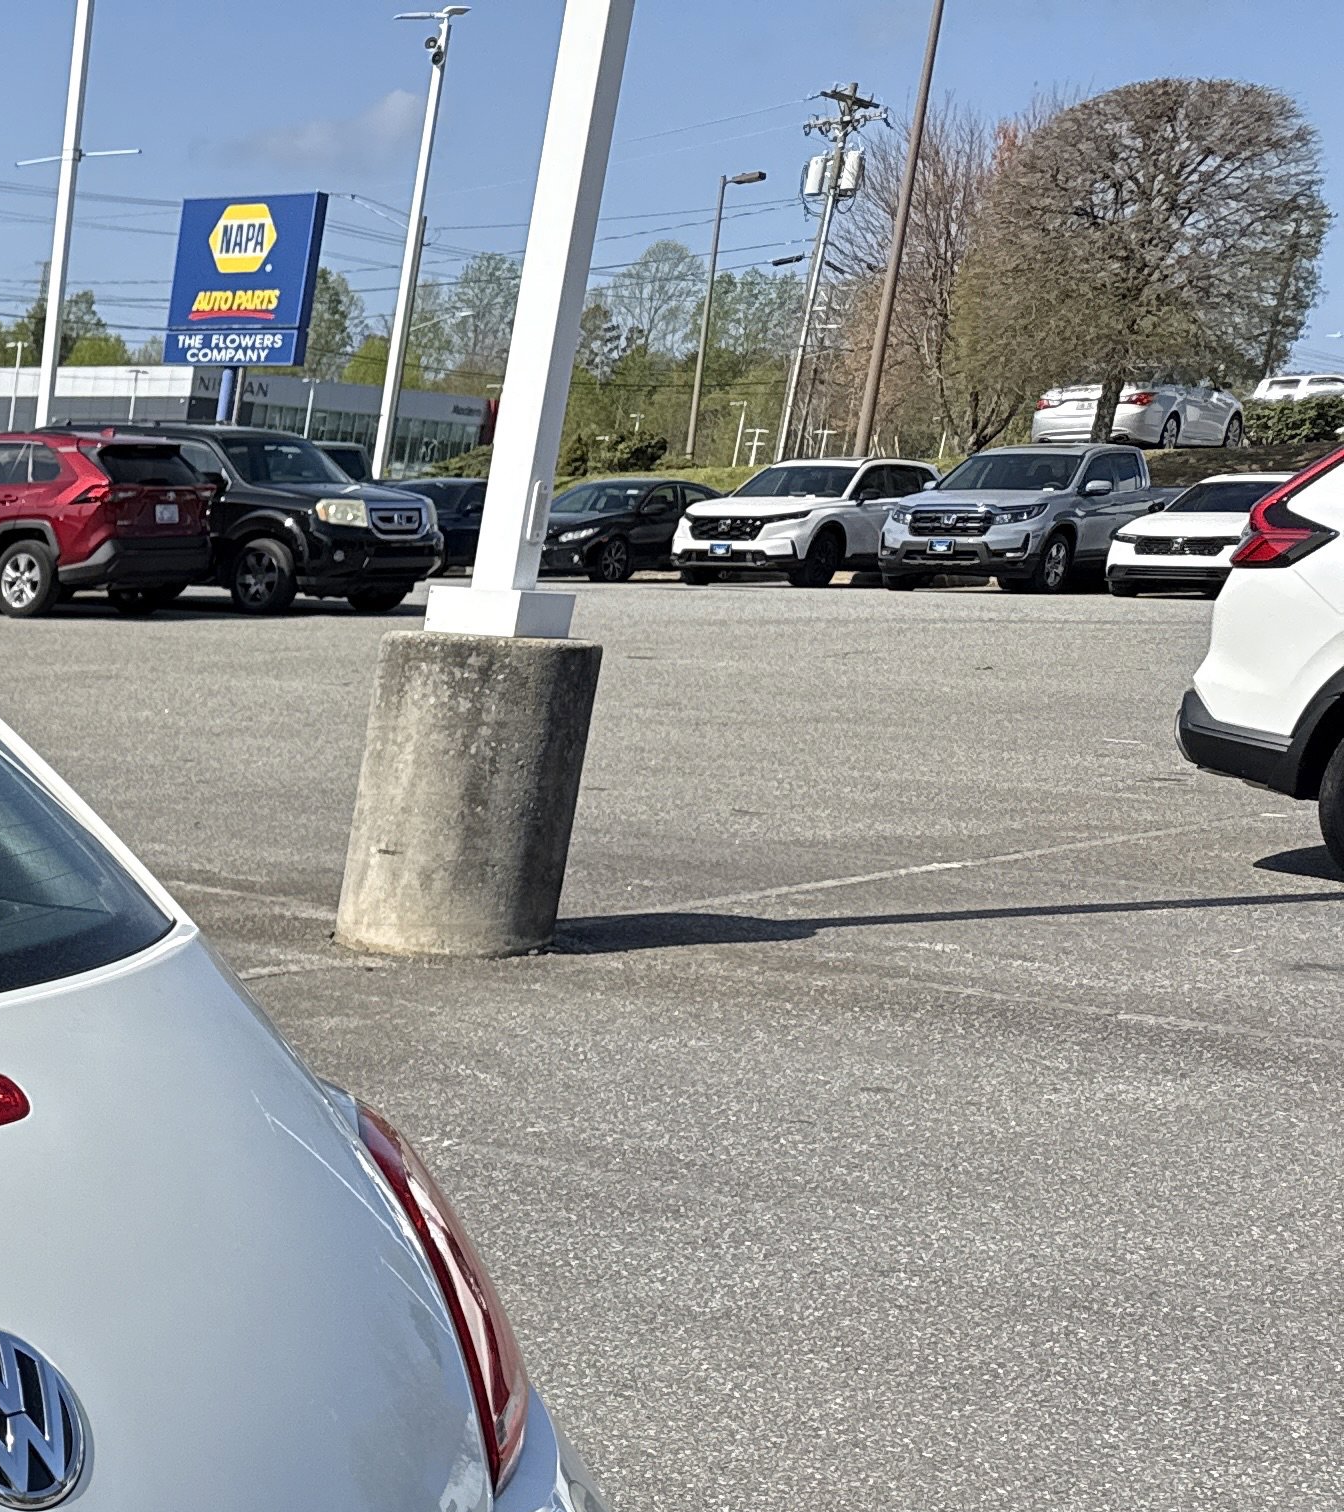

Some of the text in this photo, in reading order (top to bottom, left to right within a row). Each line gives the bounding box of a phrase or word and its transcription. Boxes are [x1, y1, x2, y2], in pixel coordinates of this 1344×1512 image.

[219, 222, 266, 255] NAPA
[191, 288, 281, 312] AUTO PARTS
[177, 333, 283, 349] THE FLOWERS
[186, 348, 269, 362] COMPANY
[197, 375, 270, 399] NIAN
